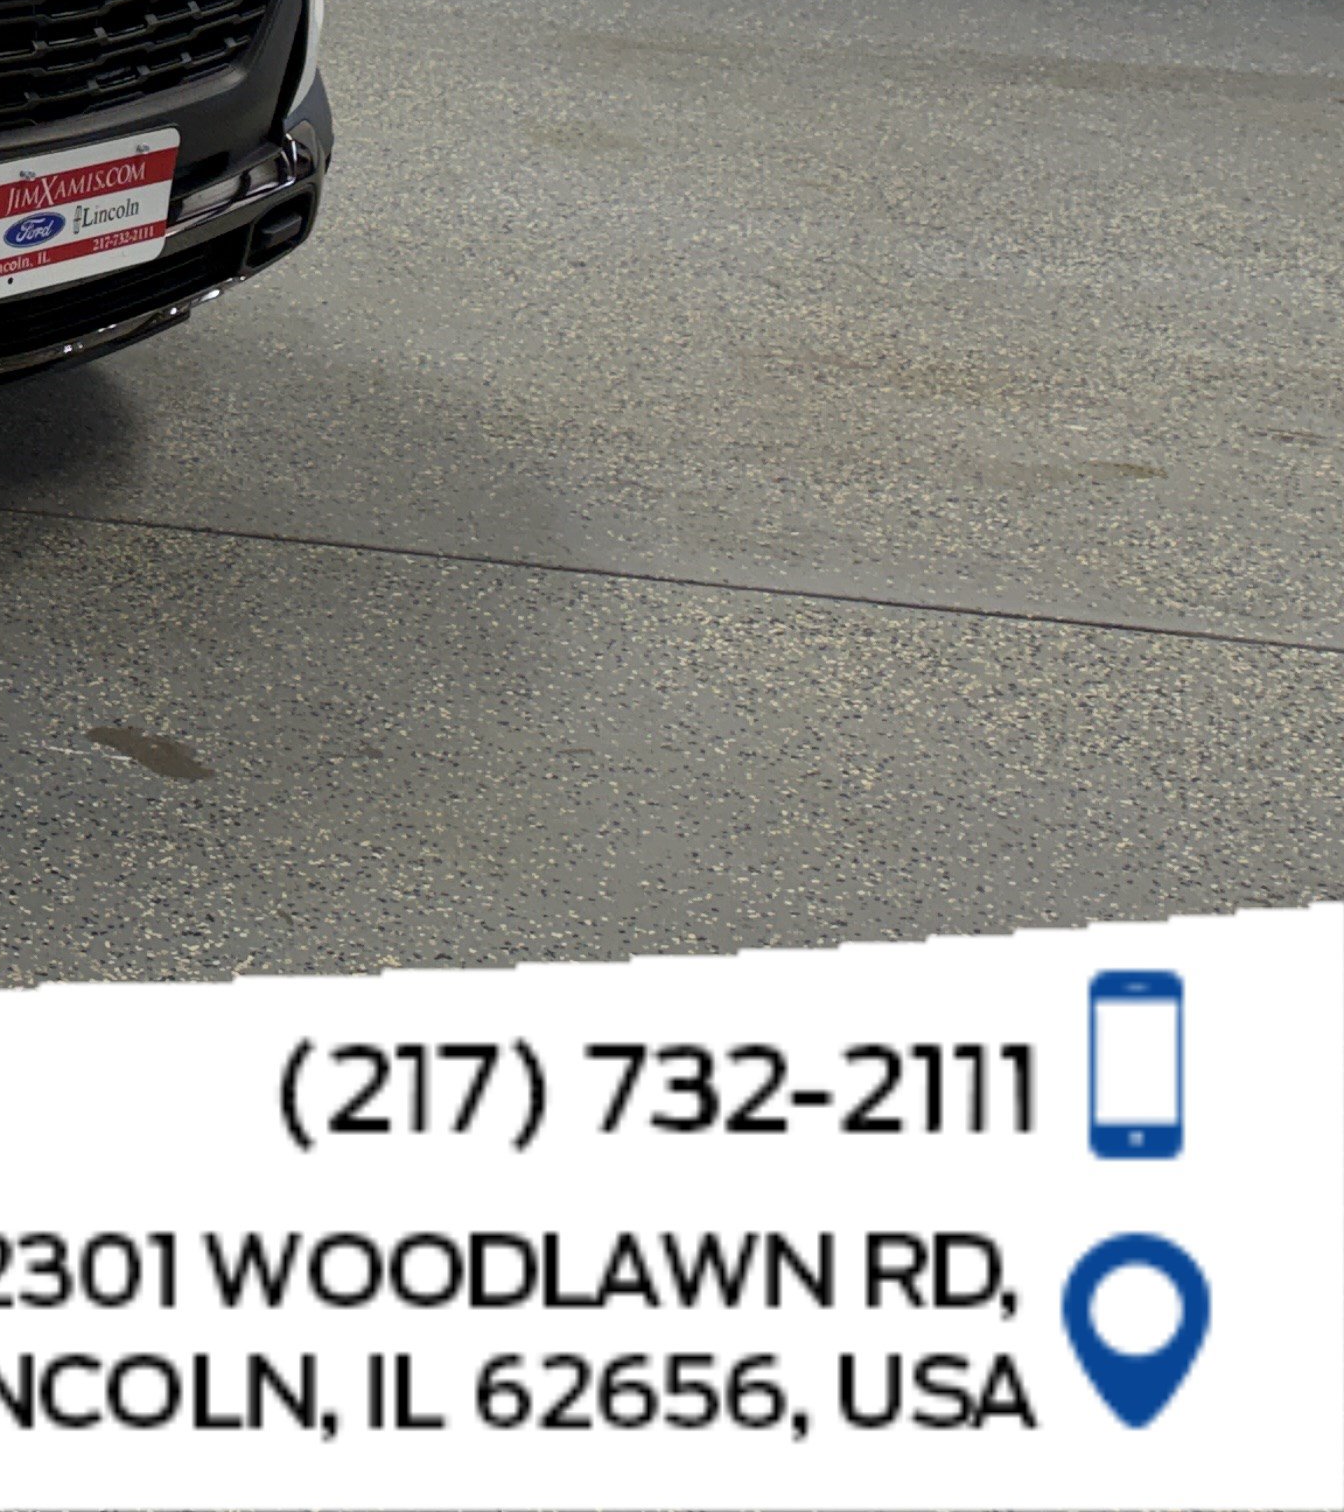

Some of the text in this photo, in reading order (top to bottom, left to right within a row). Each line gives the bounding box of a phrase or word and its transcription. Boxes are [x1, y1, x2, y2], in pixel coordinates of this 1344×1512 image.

[5, 161, 147, 217] JIMXAMIS.COM
[81, 197, 140, 228] Lincoln
[15, 218, 54, 243] Ford
[92, 225, 154, 252] 217-732-2111
[37, 251, 51, 265] IL
